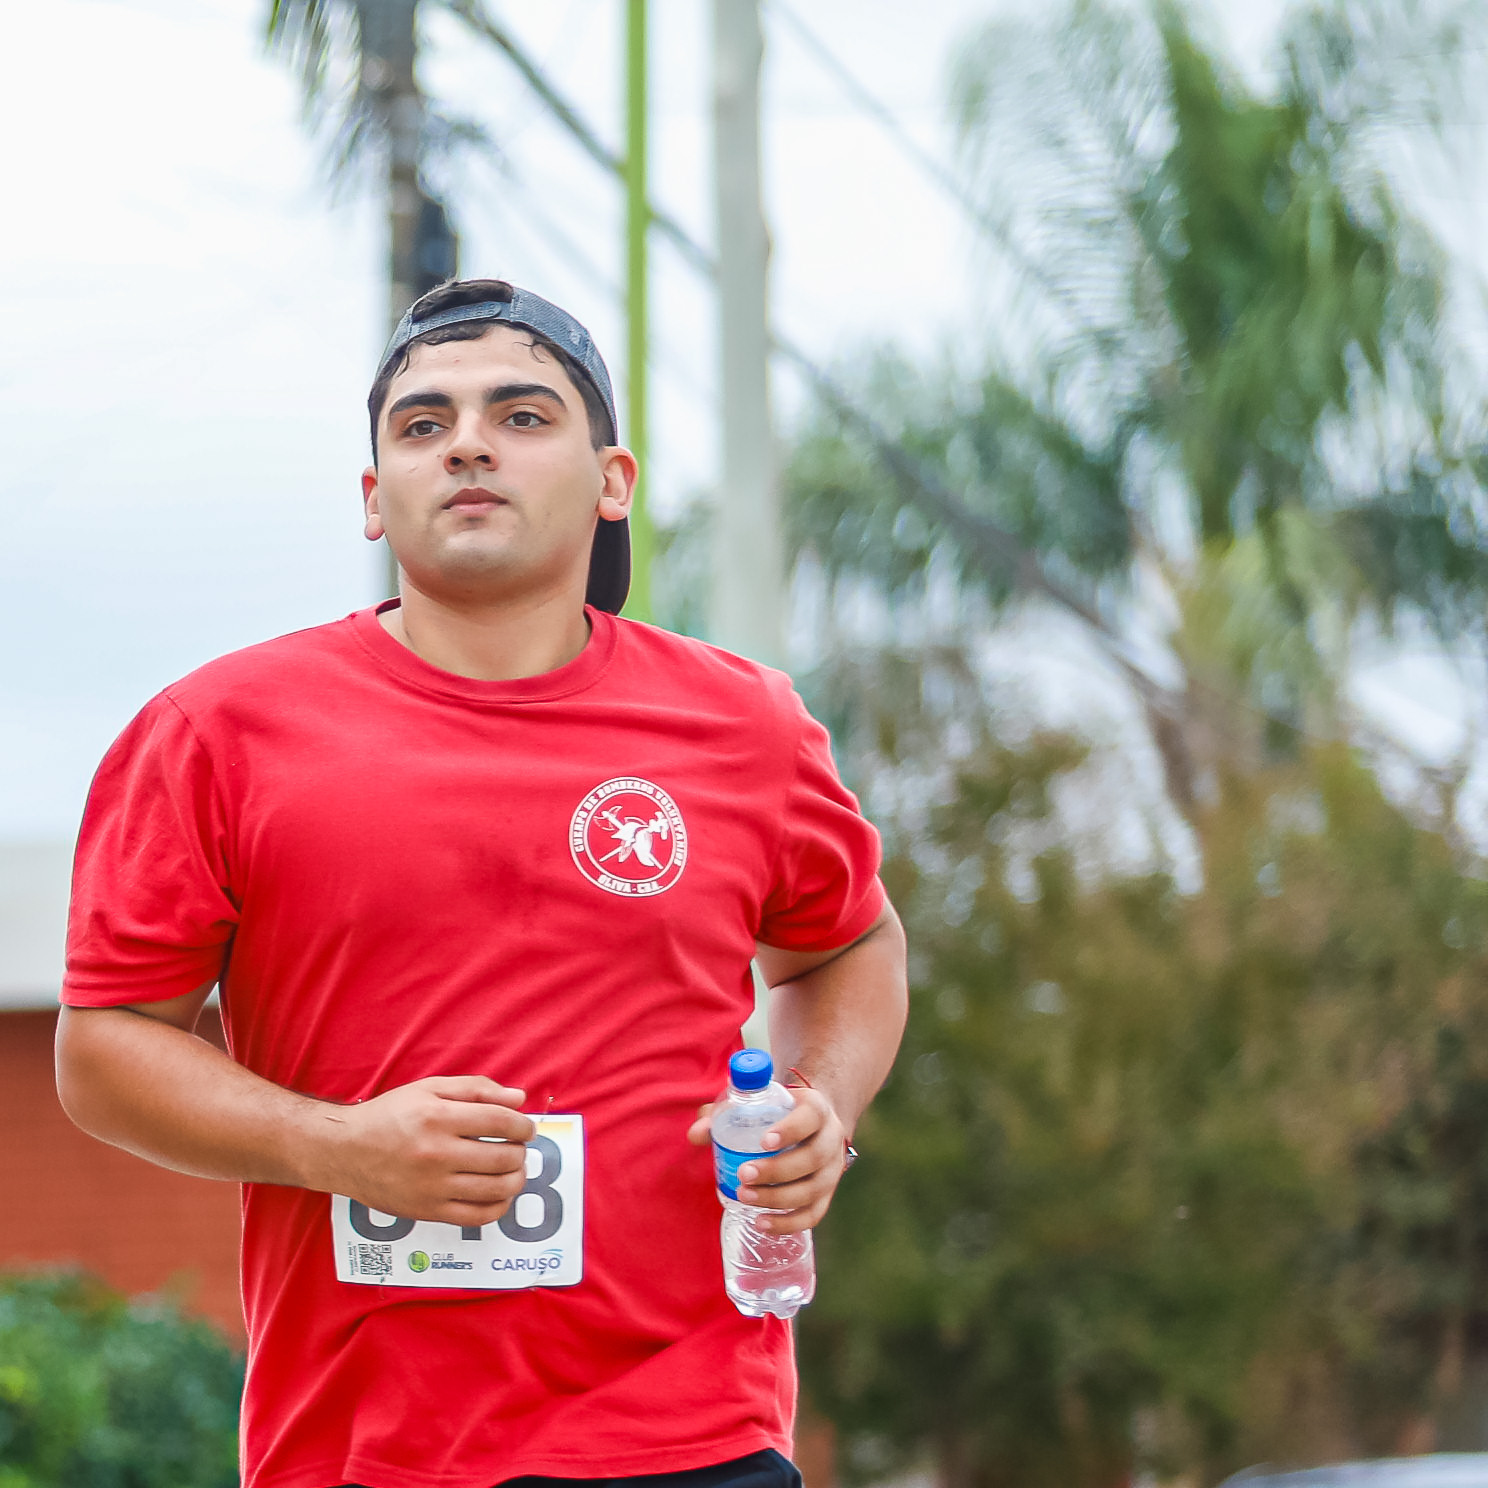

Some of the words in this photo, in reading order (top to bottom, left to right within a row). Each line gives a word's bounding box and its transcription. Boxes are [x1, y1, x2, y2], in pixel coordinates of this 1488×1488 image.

[573, 811, 588, 853] CUERPO
[596, 780, 654, 799] BOMBEROS
[431, 1253, 453, 1261] CLUB
[491, 1258, 561, 1271] CARUSO
